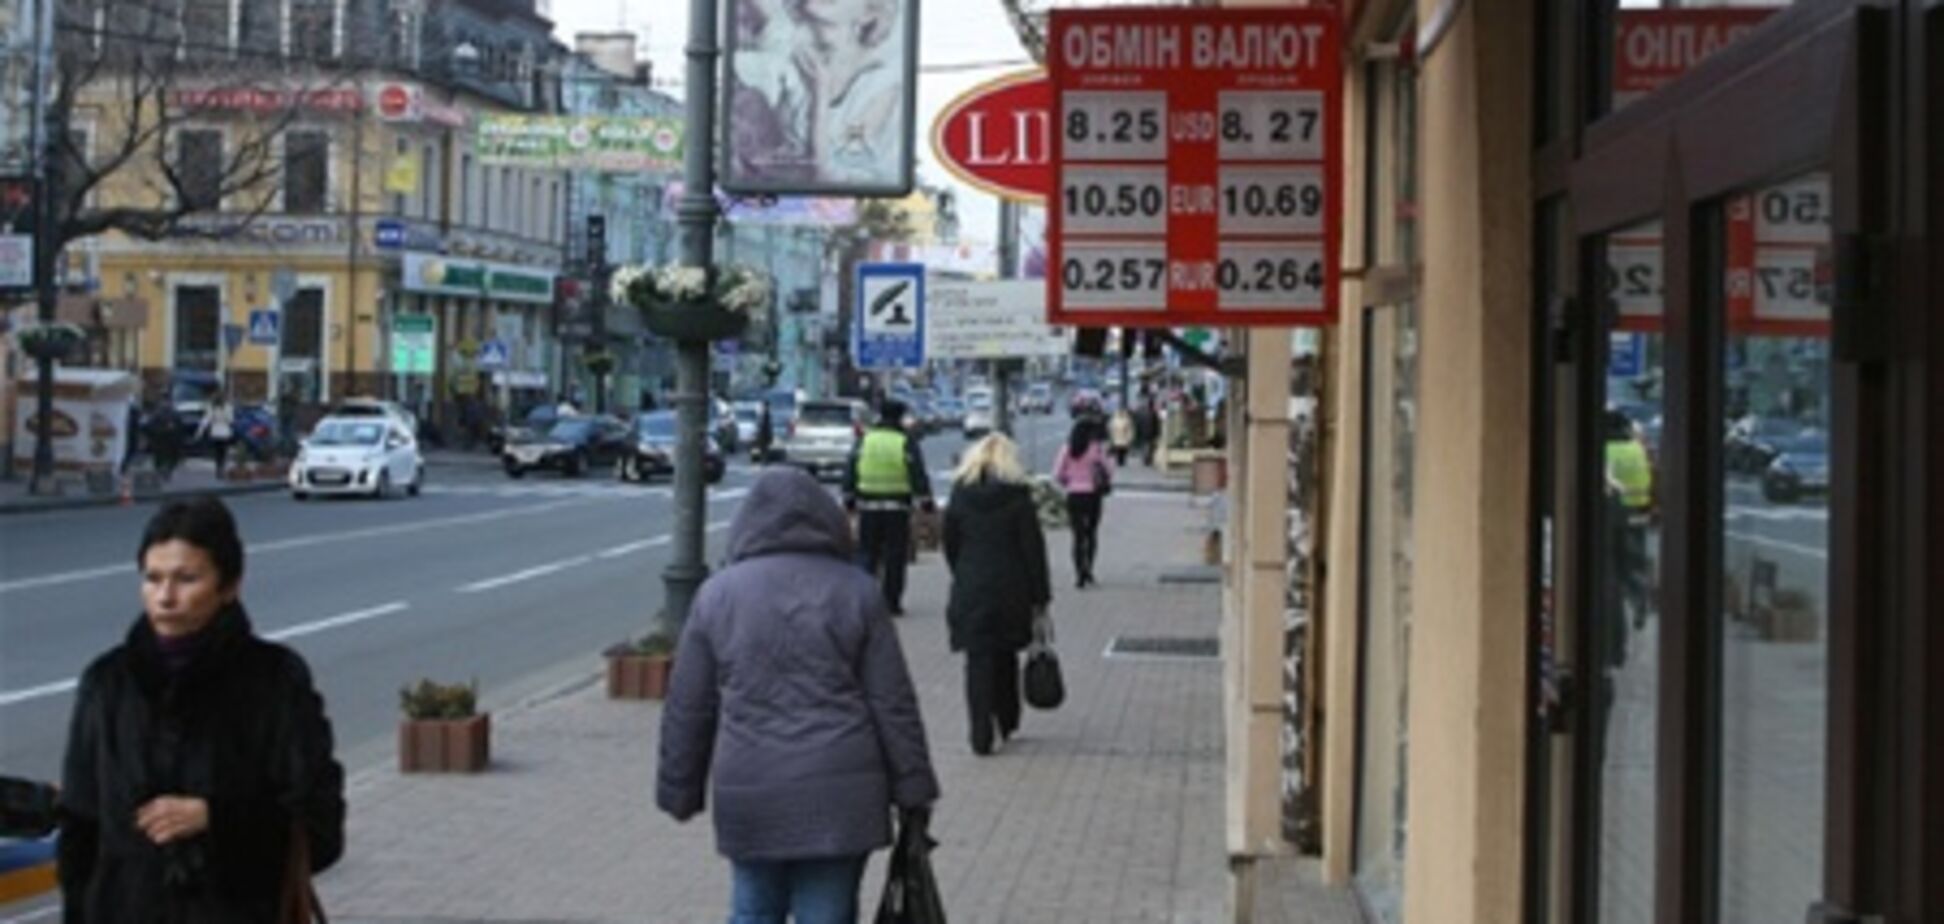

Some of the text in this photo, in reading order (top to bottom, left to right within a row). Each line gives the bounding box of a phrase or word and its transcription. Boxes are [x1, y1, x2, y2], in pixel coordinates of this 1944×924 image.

[1063, 24, 1324, 68] ОБМІН ВАЛЮТ
[1066, 110, 1160, 142] 8.25
[1170, 110, 1216, 141] USD
[1065, 184, 1323, 217] 10.50 EUR 10.69
[1062, 258, 1324, 292] 0.257 RUR 0.264
